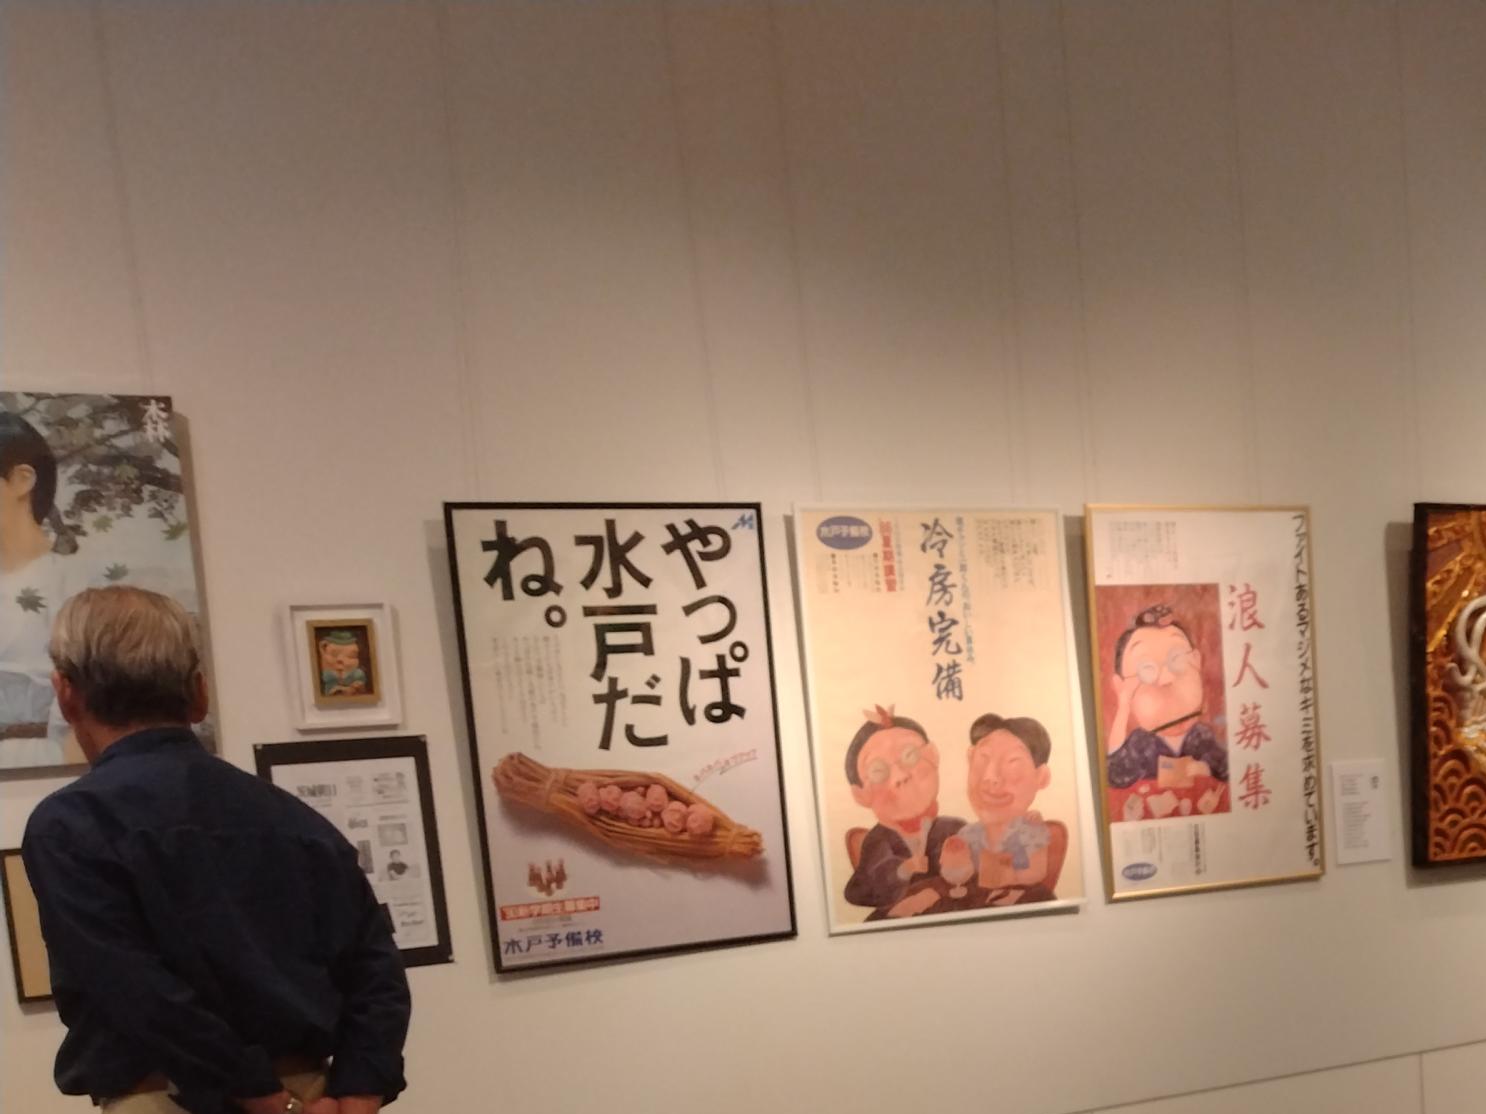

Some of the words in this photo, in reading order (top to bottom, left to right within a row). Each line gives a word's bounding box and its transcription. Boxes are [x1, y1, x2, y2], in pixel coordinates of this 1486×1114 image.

[482, 519, 567, 629] ね。
[574, 518, 669, 750] 水戸だ
[661, 517, 750, 727] やっぱ
[920, 517, 965, 702] 冷房完備
[1227, 583, 1273, 811] 浪人募集
[504, 928, 604, 954] 水戸予備校
